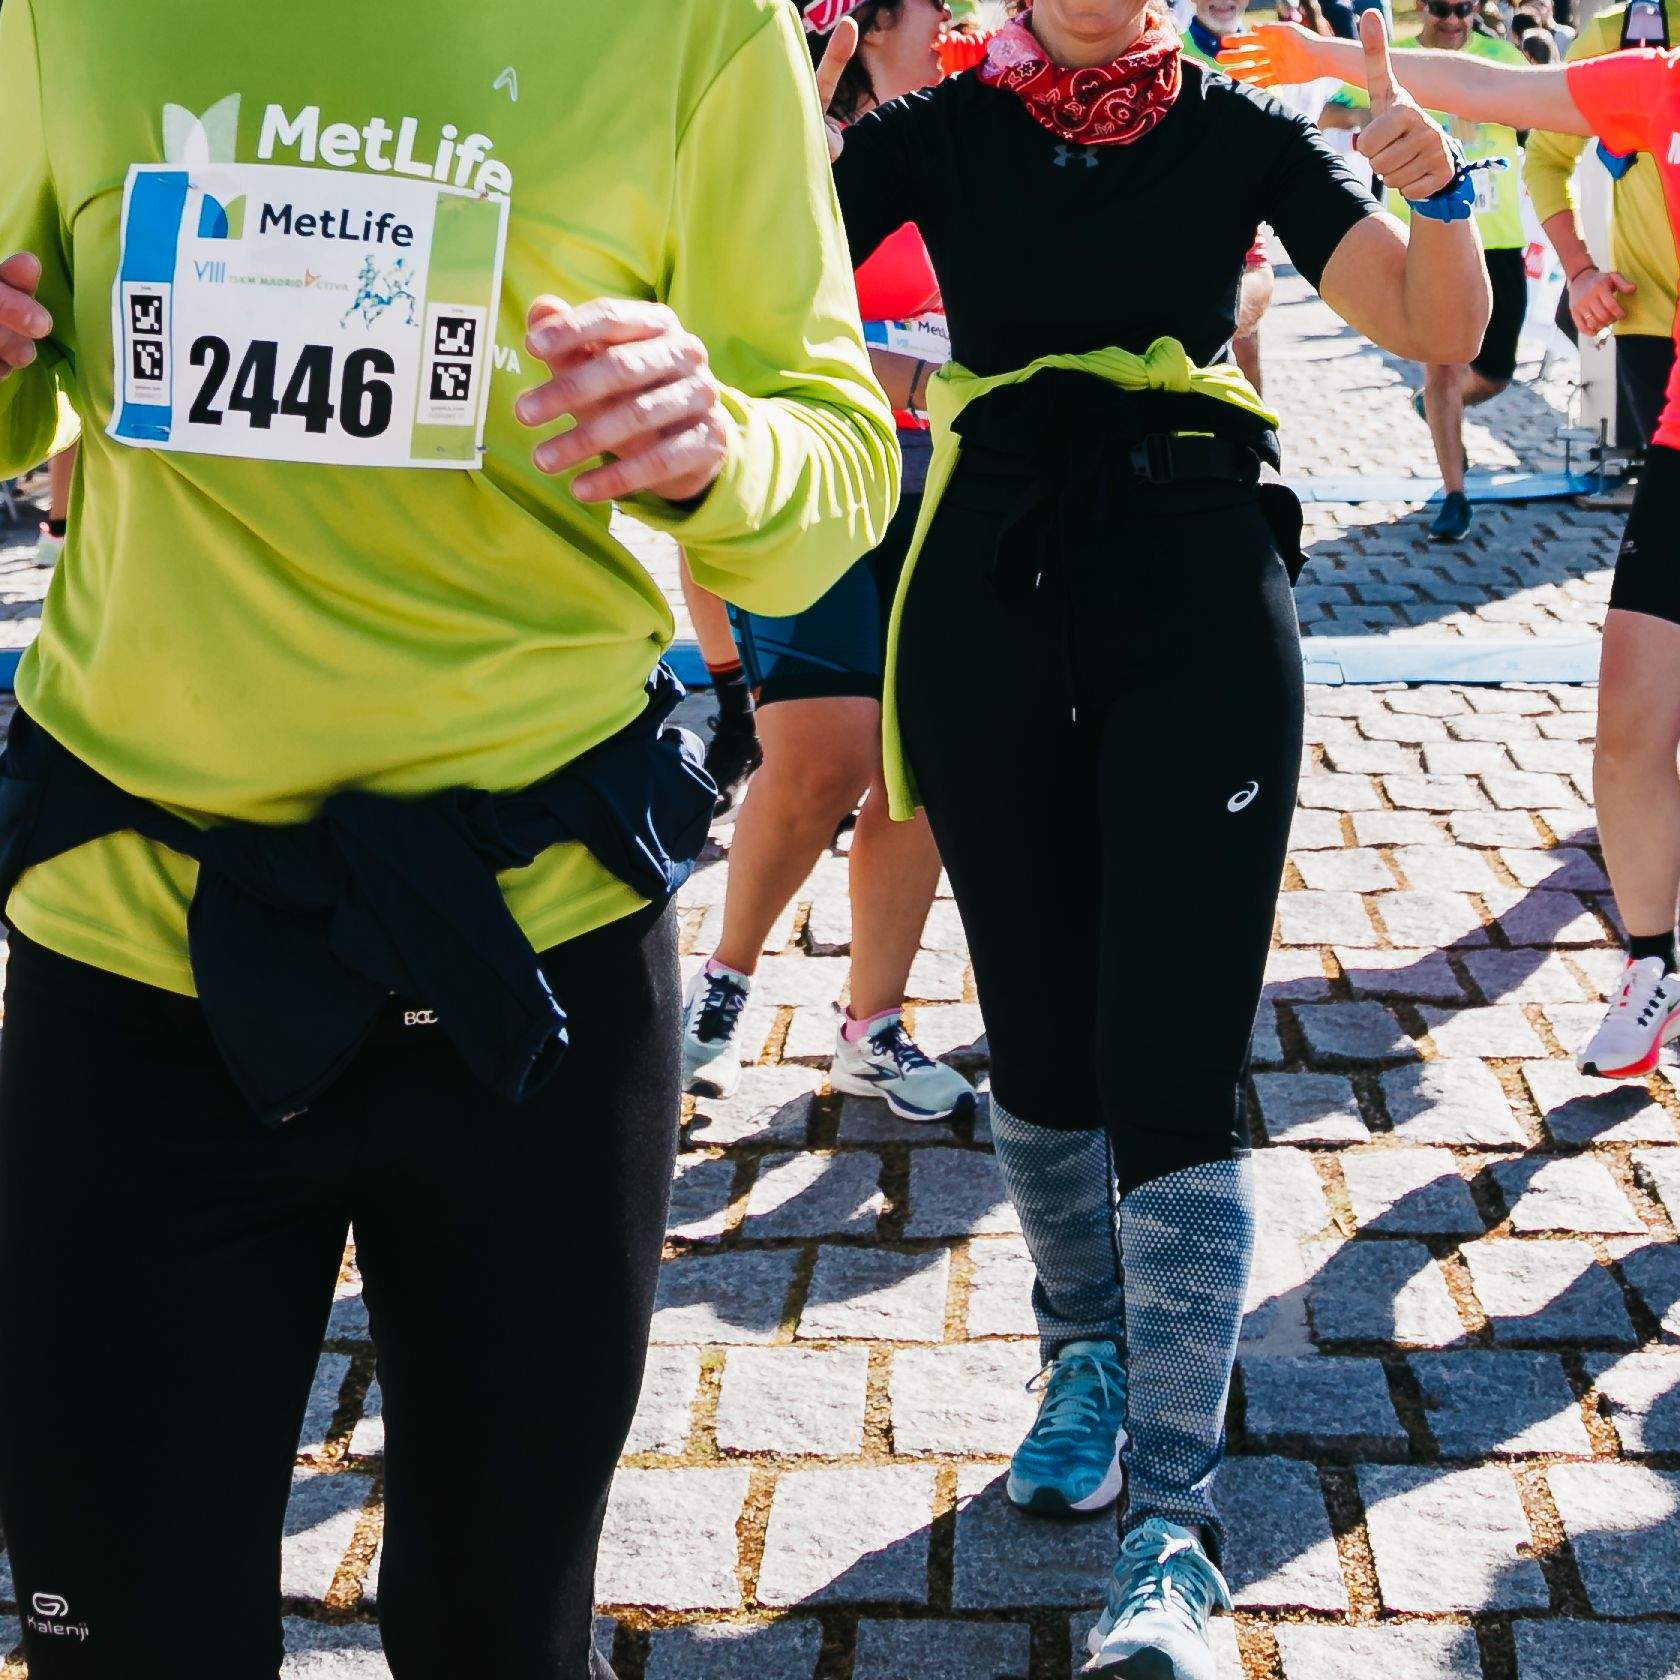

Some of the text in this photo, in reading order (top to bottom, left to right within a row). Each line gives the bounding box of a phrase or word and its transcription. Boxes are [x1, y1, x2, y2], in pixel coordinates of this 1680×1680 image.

[257, 104, 513, 196] MetLife
[259, 202, 415, 248] MetLife
[194, 260, 226, 284] VIII
[189, 335, 396, 439] 2446
[26, 1615, 89, 1642] Kalenji
